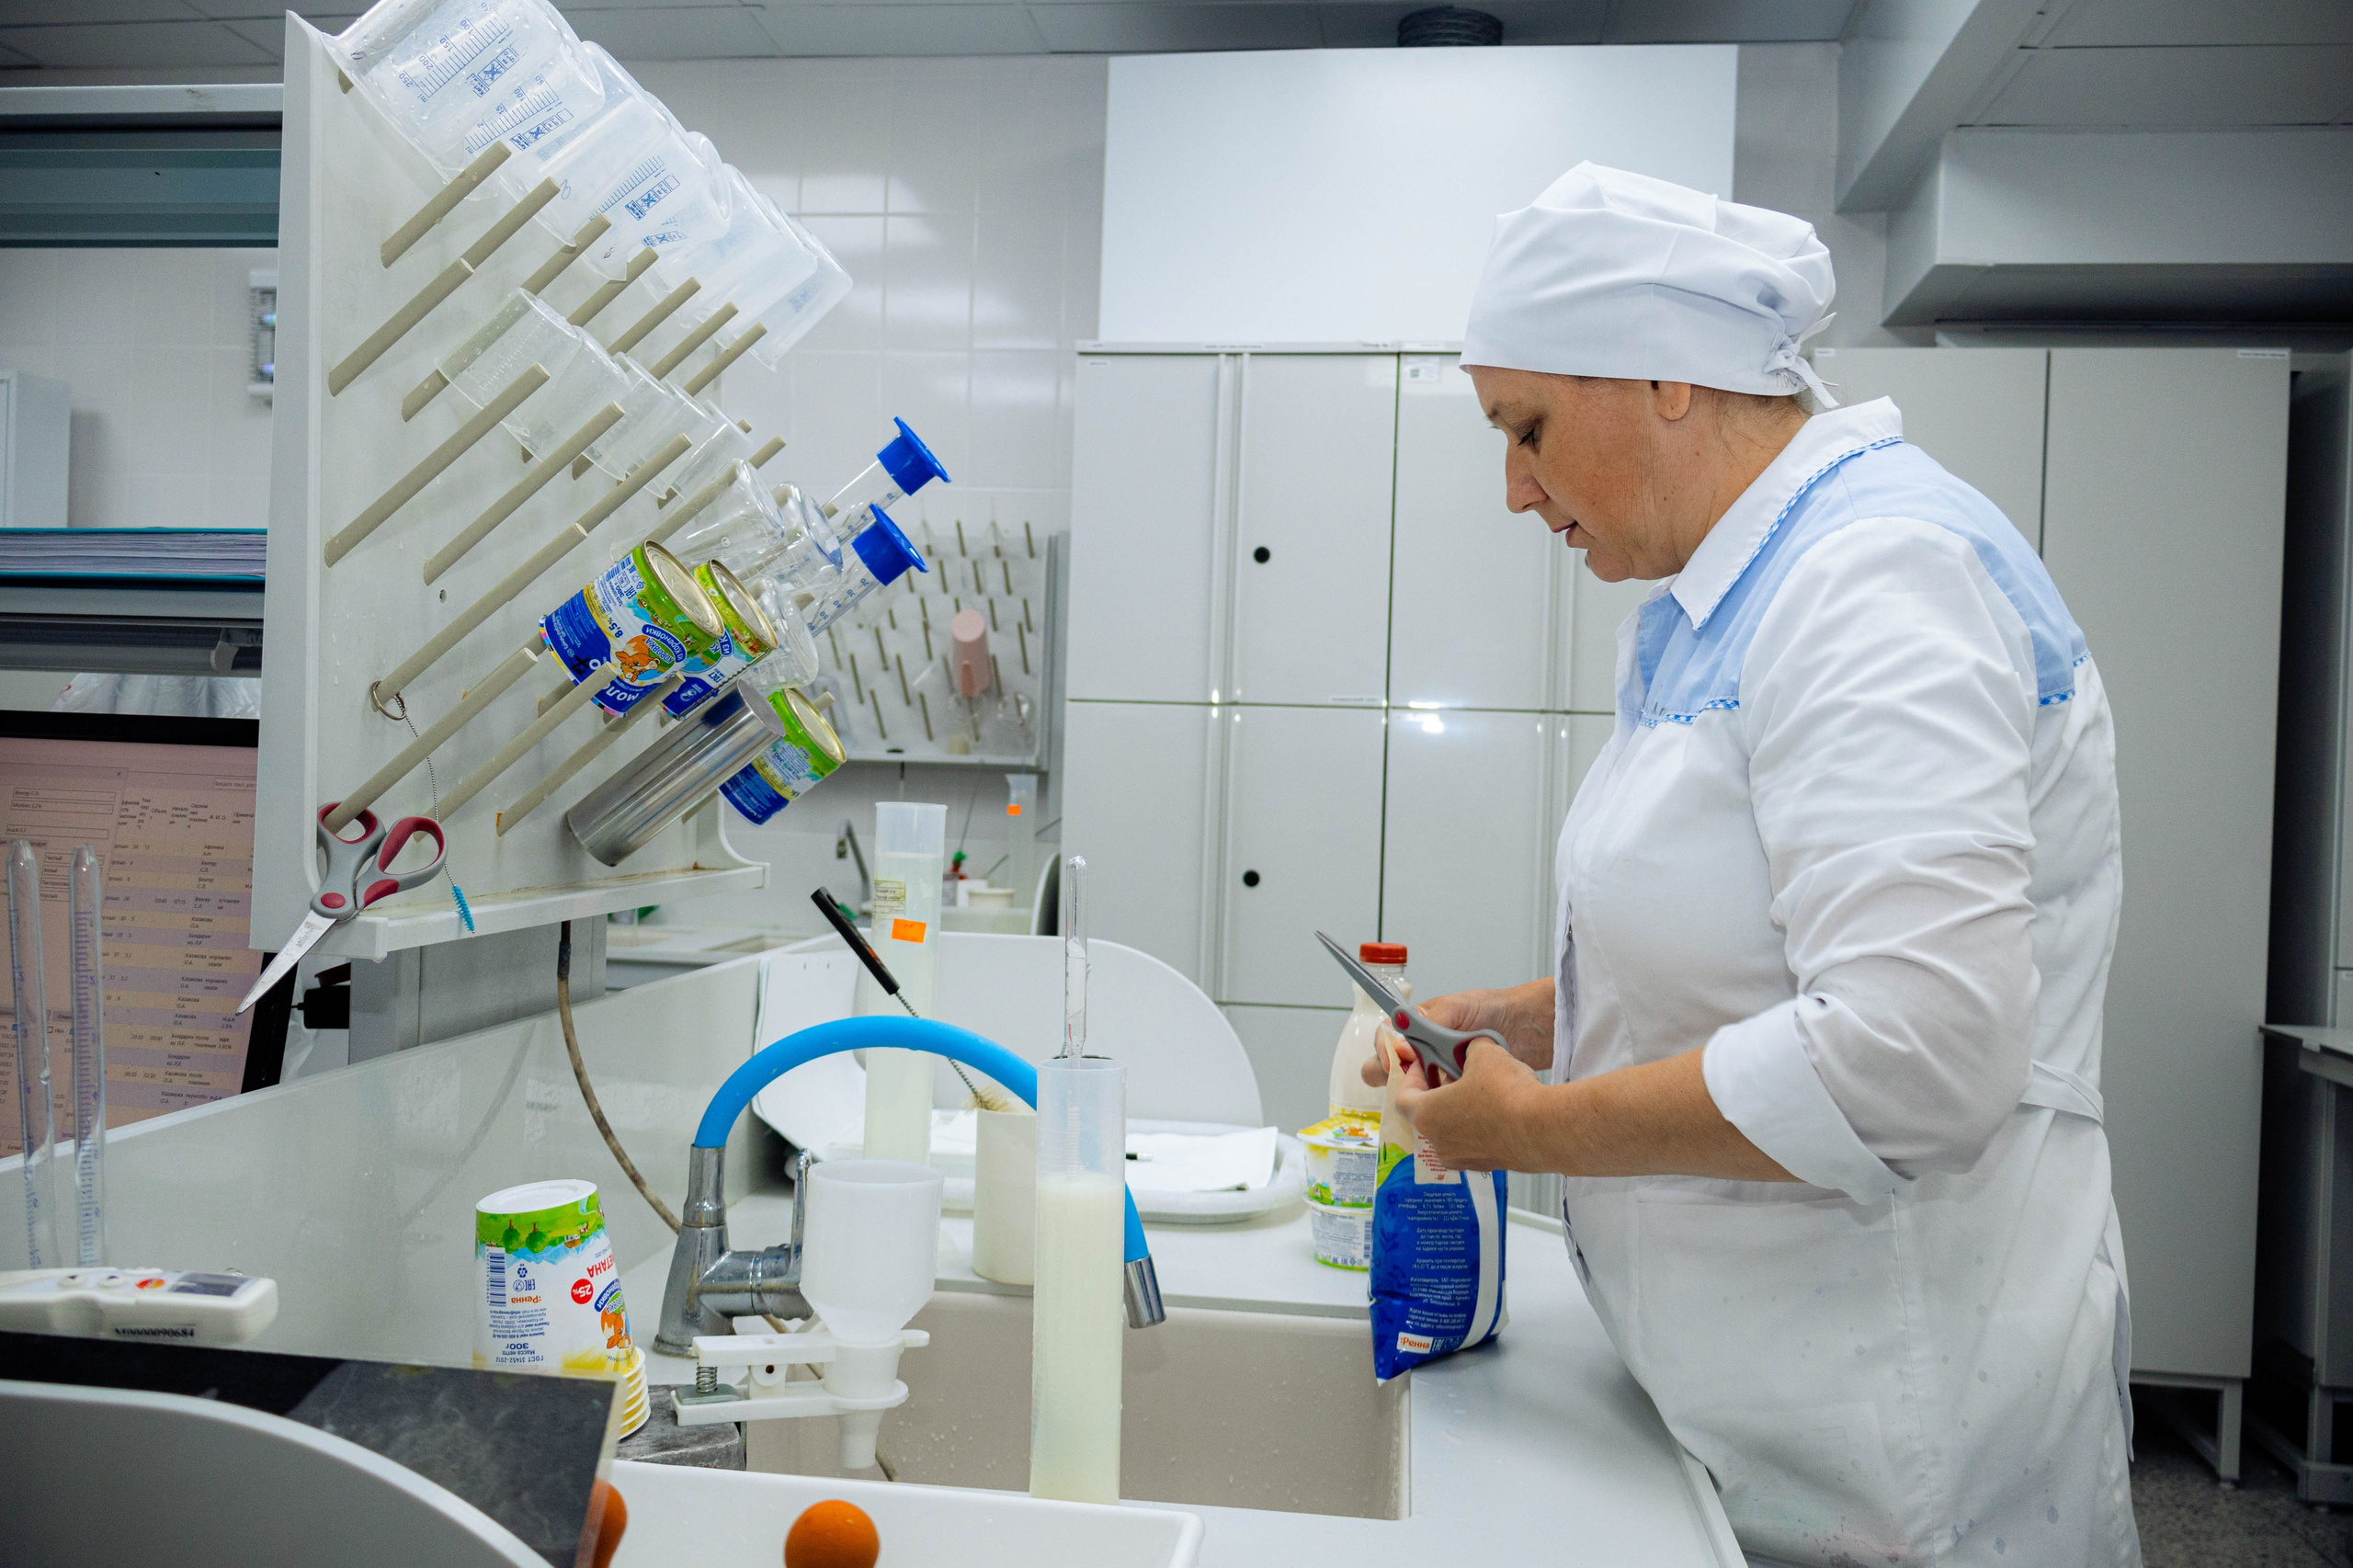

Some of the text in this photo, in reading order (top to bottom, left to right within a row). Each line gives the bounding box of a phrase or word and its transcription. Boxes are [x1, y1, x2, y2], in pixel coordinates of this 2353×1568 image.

[460, 19, 474, 35] 100
[439, 38, 453, 52] 150
[419, 55, 434, 71] 200
[398, 73, 414, 88] 250
[417, 93, 428, 103] ml
[514, 88, 526, 102] 100
[860, 577, 870, 586] 20
[847, 589, 856, 597] 30
[834, 600, 842, 608] 40
[643, 636, 674, 663] КОРОВКА
[572, 1285, 591, 1297] 25%
[527, 1354, 543, 1362] ГОСТ
